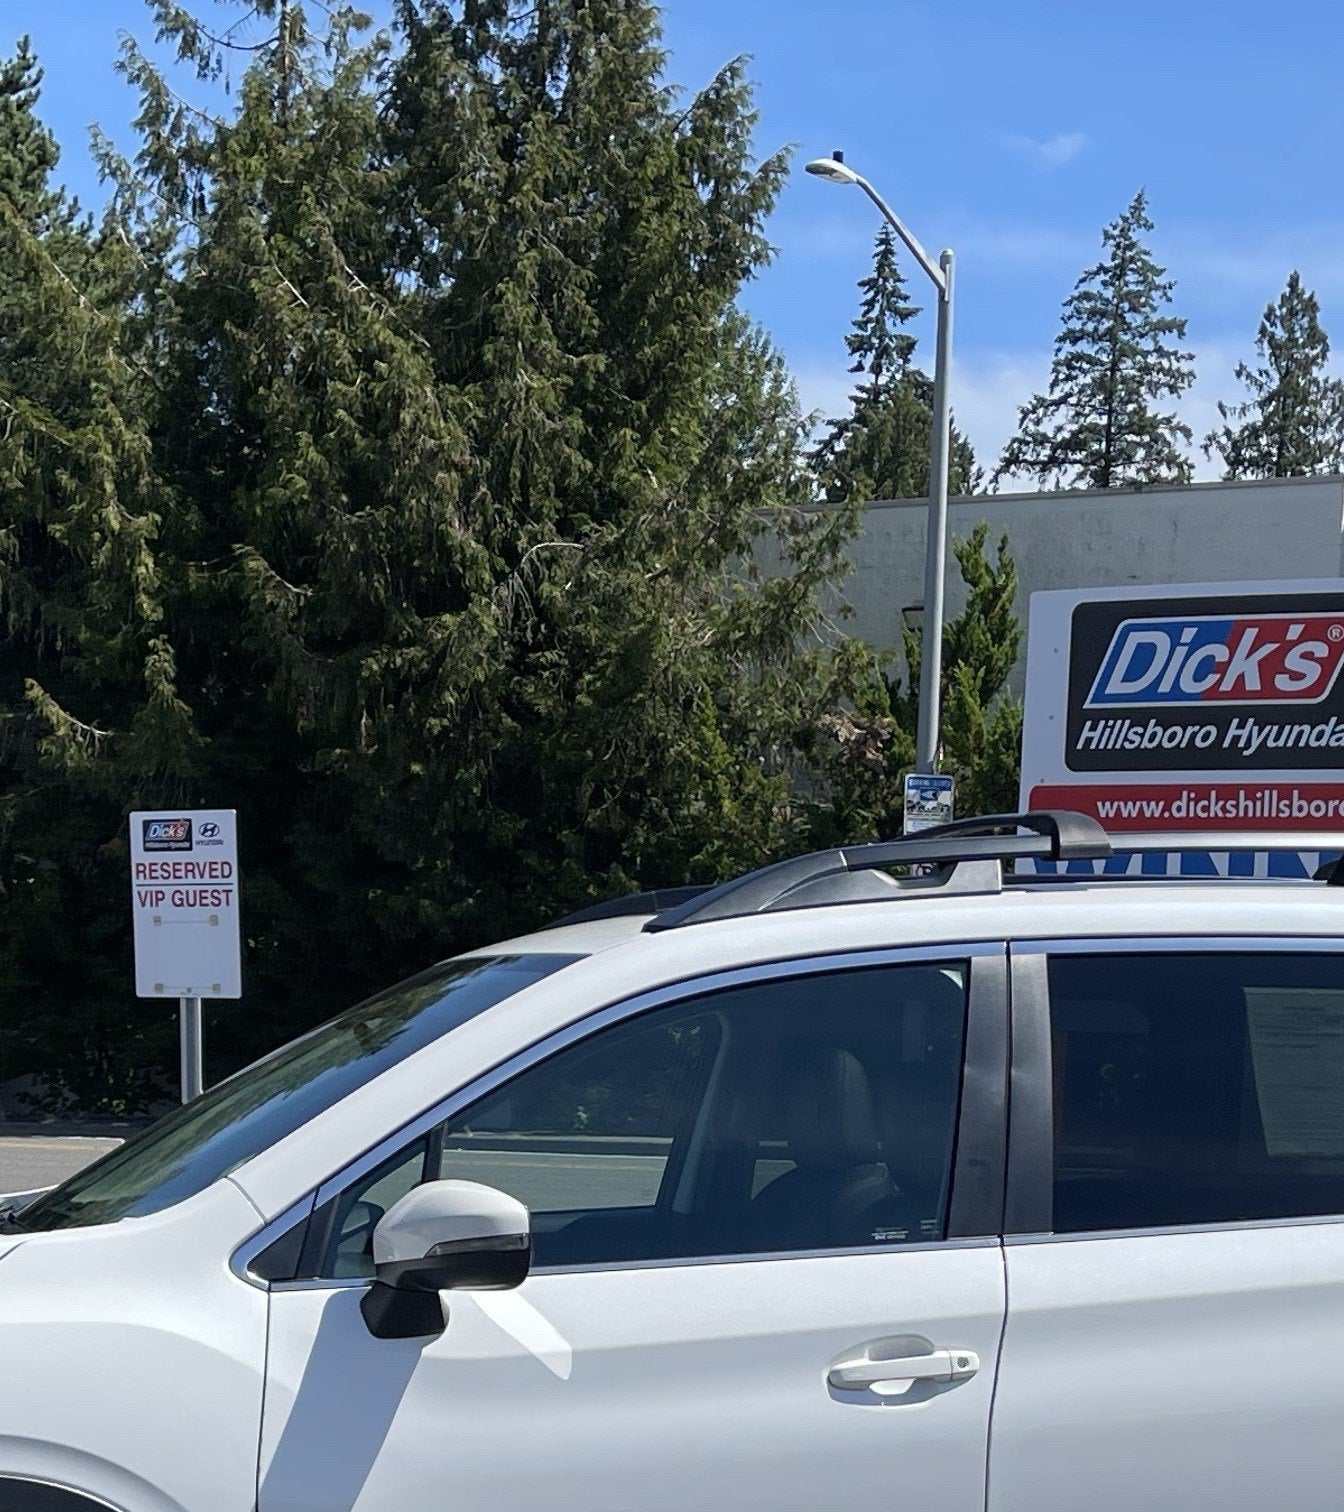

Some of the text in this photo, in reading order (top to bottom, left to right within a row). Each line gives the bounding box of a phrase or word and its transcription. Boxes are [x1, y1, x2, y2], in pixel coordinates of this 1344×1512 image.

[1076, 718, 1218, 750] Hillsboro
[135, 861, 233, 880] RESERVED
[137, 889, 233, 908] VIP GUEST
